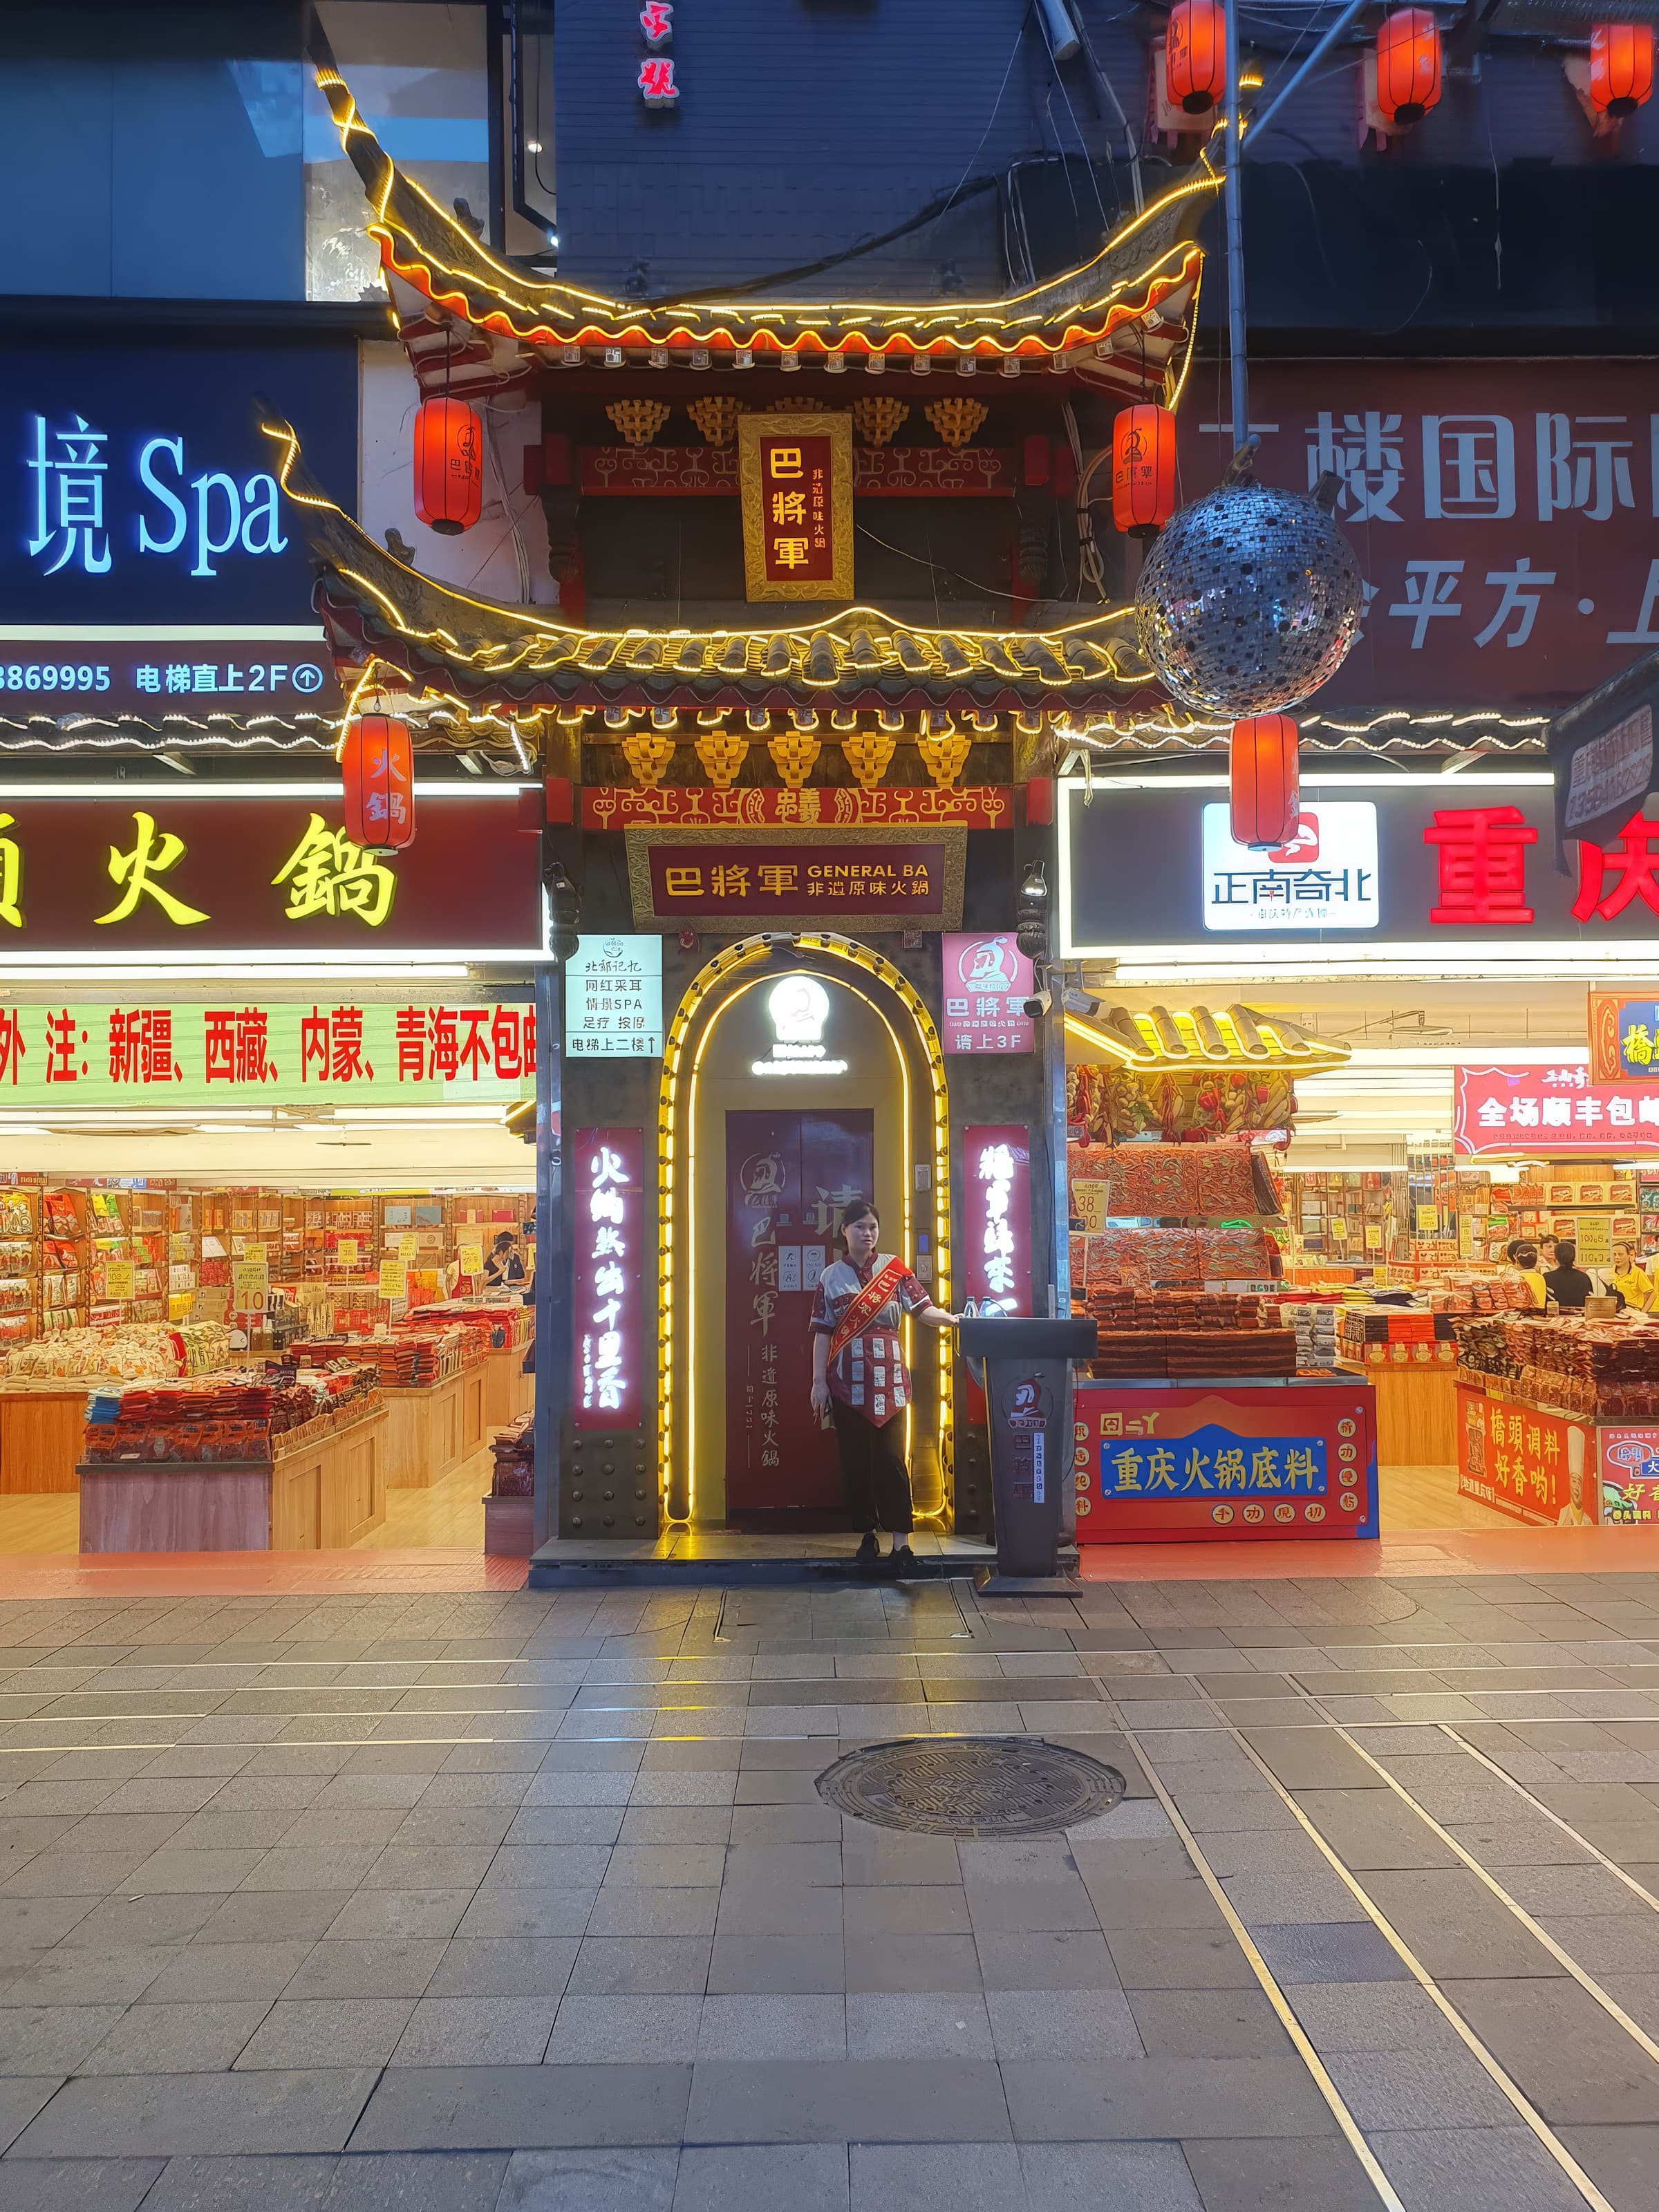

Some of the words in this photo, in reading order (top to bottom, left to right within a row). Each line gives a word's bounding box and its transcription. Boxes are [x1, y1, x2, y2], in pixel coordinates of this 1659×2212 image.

[28, 414, 112, 576] 境
[139, 436, 288, 576] Spa
[136, 664, 288, 693] 电梯直上2F
[807, 865, 896, 877] GENERAL
[903, 864, 928, 877] BA
[1211, 869, 1371, 904] 正南奇北
[1078, 1196, 1094, 1212] 38
[241, 1291, 264, 1310] 10
[1111, 1446, 1319, 1492] 重庆火锅底料
